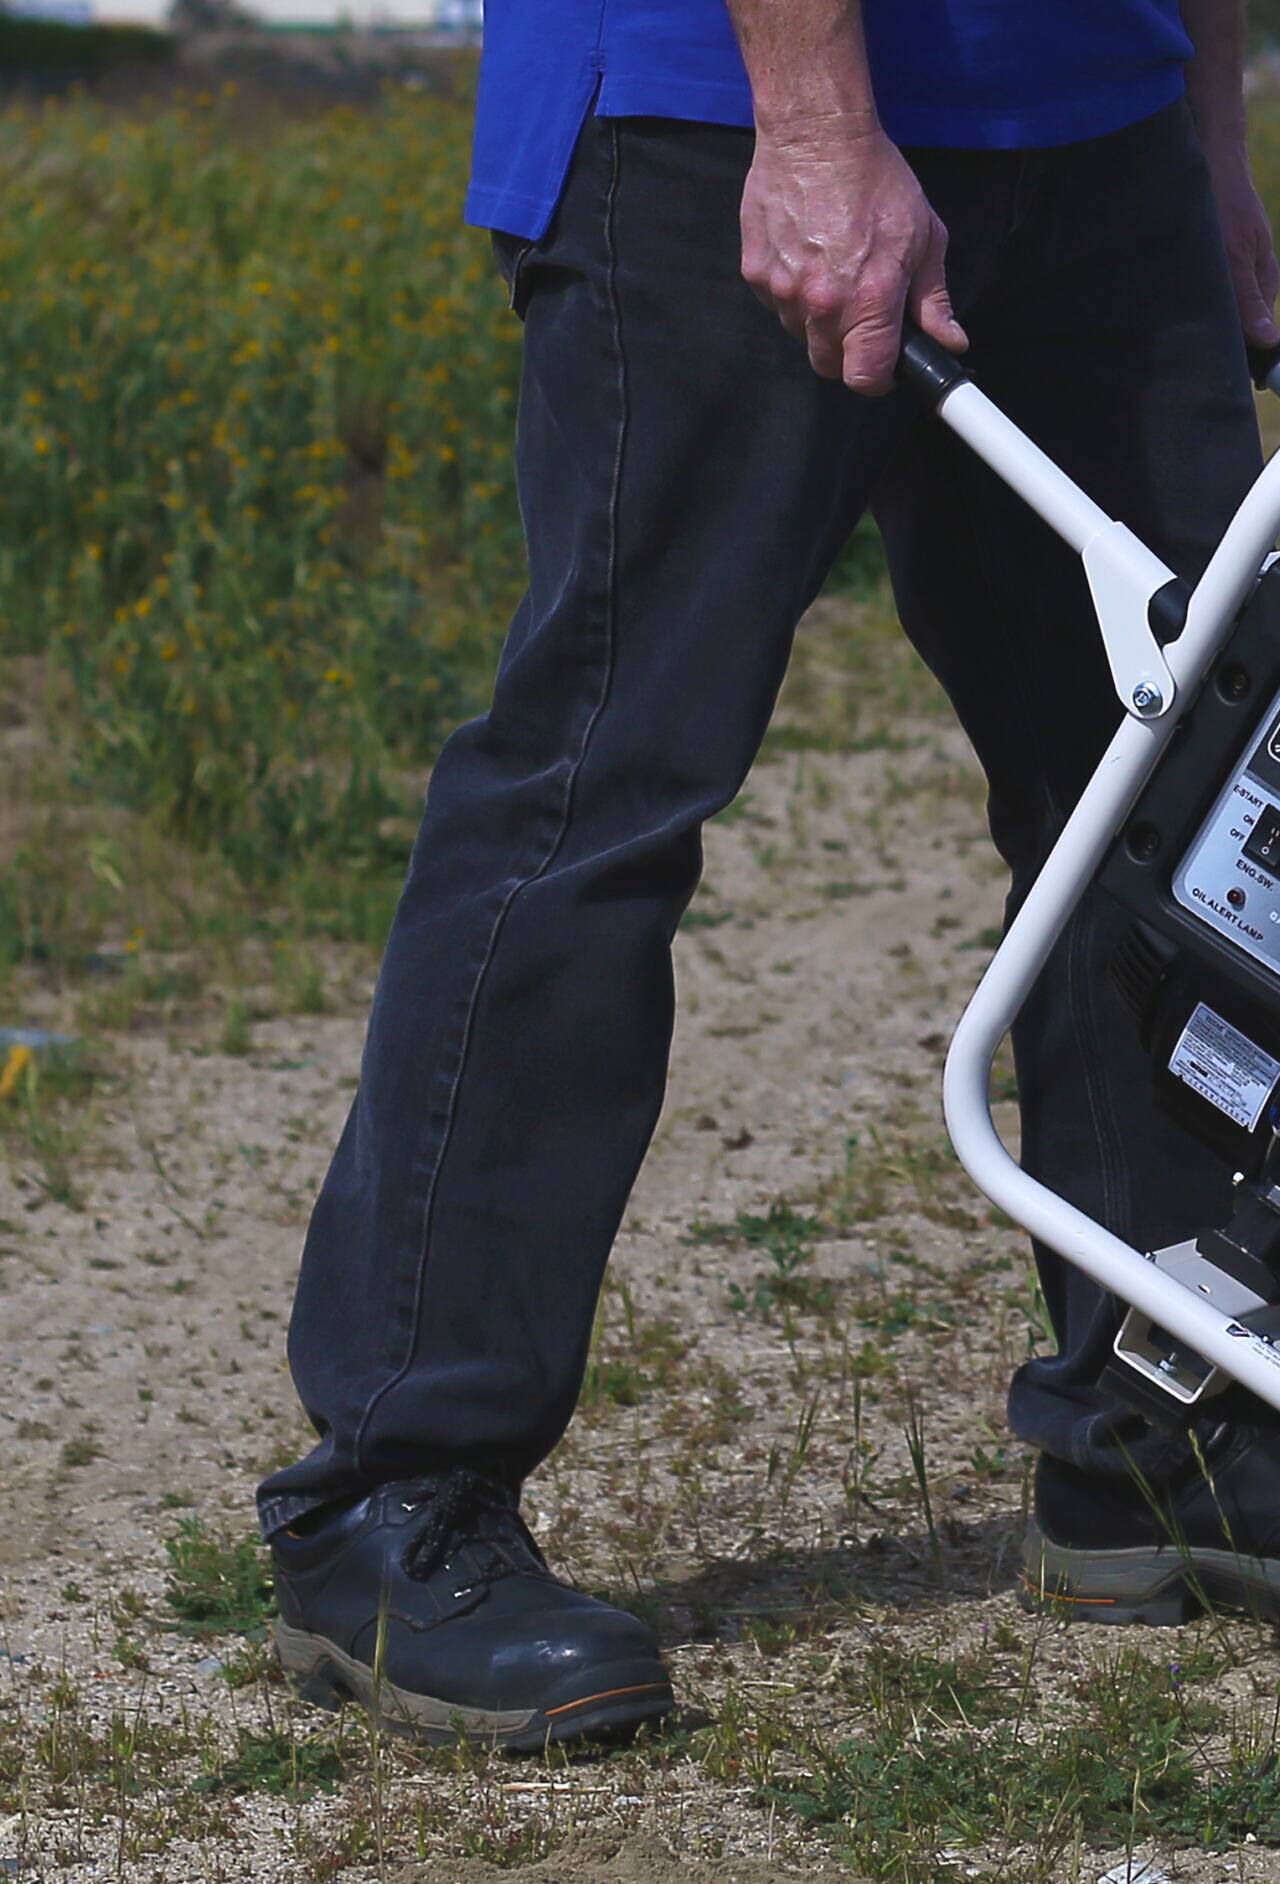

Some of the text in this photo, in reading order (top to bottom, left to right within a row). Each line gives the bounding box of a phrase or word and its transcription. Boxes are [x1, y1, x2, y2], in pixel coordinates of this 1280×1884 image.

[1233, 784, 1263, 809] E-START
[1243, 814, 1255, 826] ON
[1230, 828, 1246, 842] OFF
[1236, 859, 1274, 892] ENG.SW.
[1192, 888, 1264, 942] OIL ALERT LAMP
